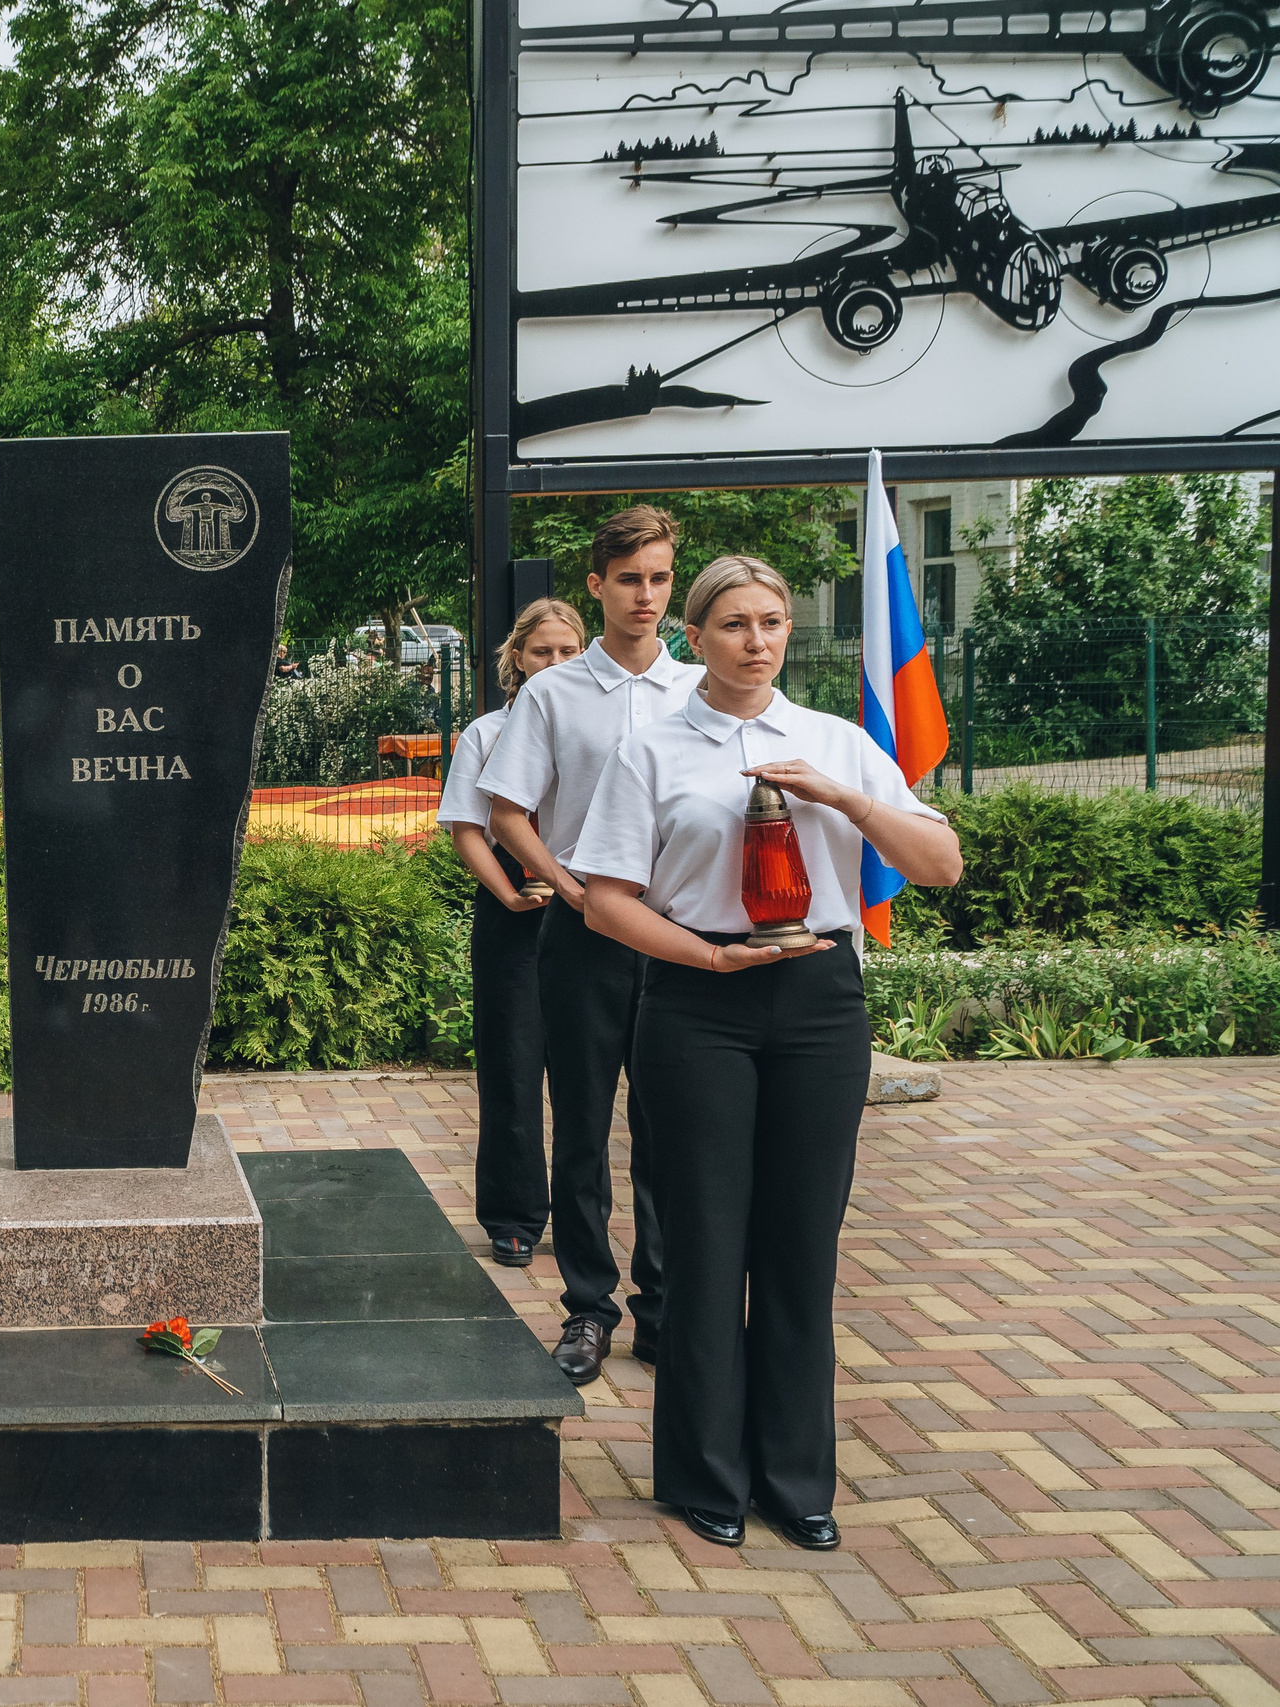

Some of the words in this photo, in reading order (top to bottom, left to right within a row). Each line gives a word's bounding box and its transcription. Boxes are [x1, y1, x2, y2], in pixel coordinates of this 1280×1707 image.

[53, 614, 202, 644] ПАМЯТЬ
[117, 663, 143, 690] О
[95, 706, 165, 734] ВАС
[71, 755, 192, 783] ВЕЧНА
